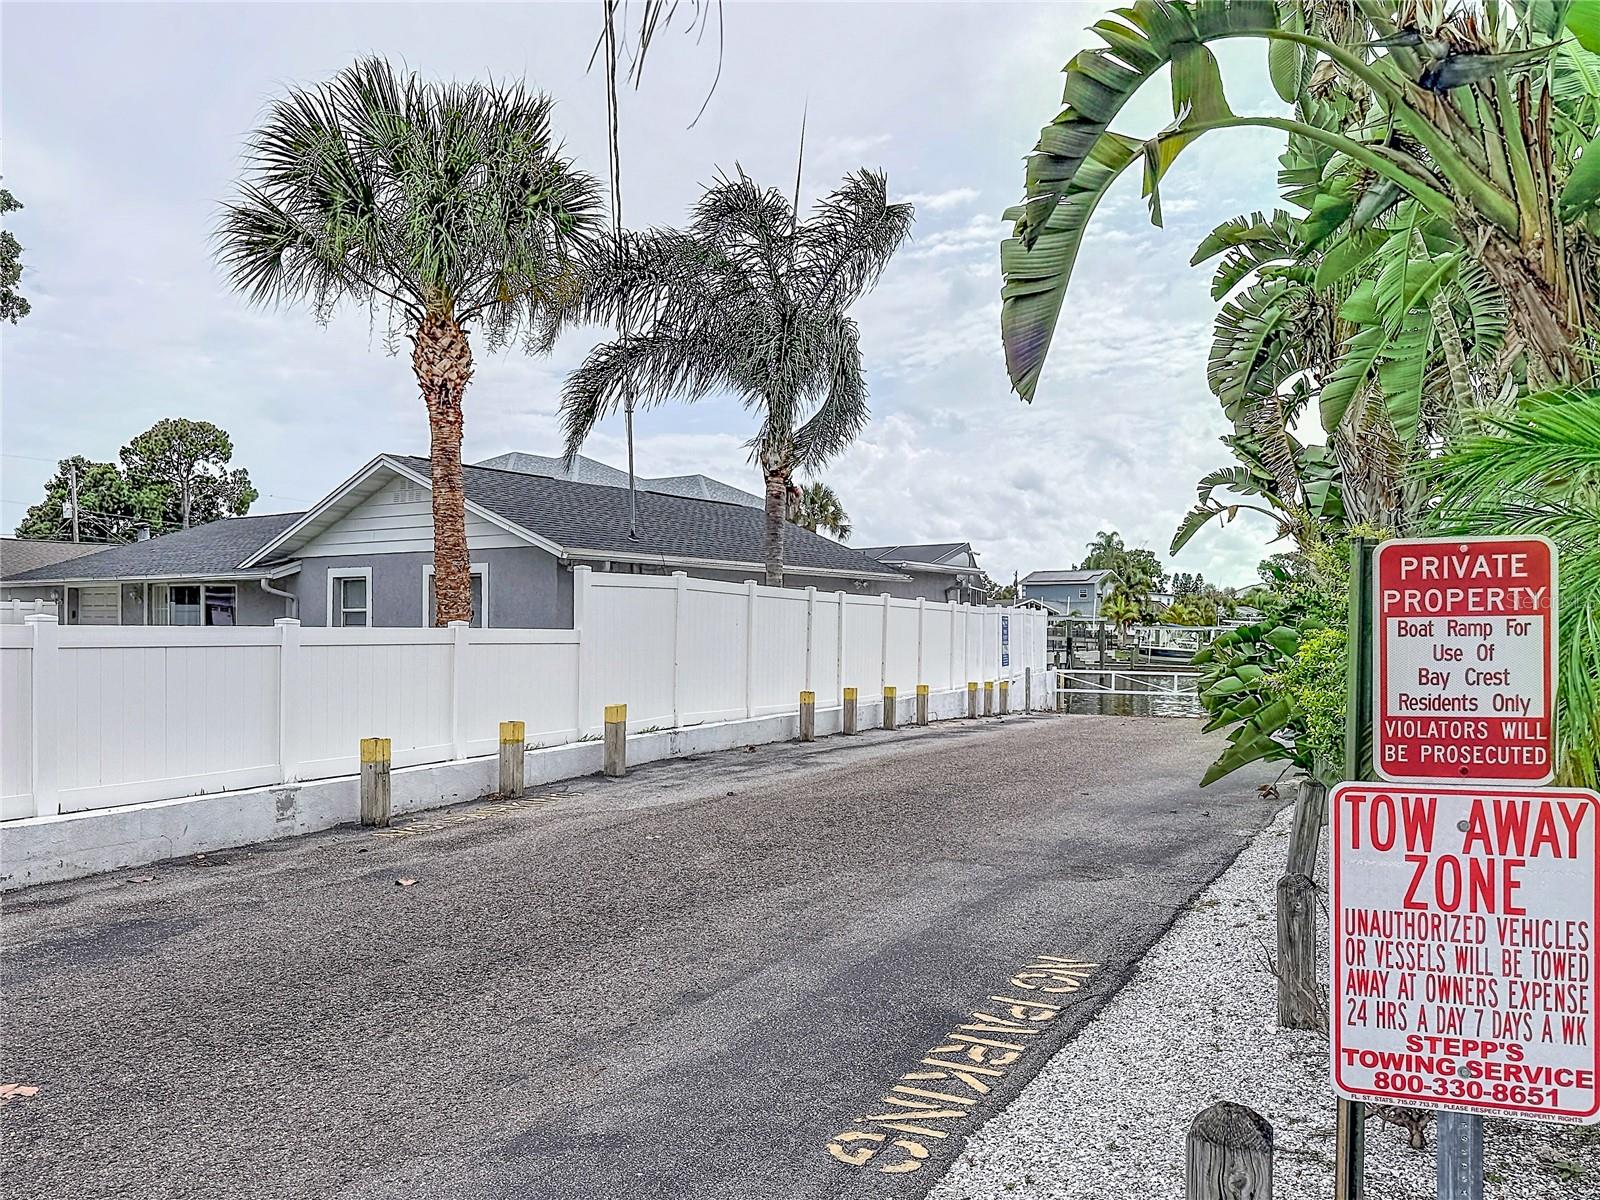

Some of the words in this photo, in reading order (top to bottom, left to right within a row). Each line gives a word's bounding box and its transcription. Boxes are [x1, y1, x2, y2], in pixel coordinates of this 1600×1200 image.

[1401, 553, 1528, 580] PRIVATE
[1383, 586, 1546, 613] PROPERTY
[1398, 620, 1434, 638] Boat
[1447, 619, 1493, 640] Ramp
[1506, 618, 1532, 637] For
[1433, 644, 1463, 662] Use
[1477, 644, 1495, 662] Of
[1418, 668, 1450, 690] Bay
[1465, 668, 1510, 686] Crest
[1399, 693, 1478, 711] Residents
[1493, 693, 1531, 716] Only
[1385, 720, 1488, 739] VIOLATORS
[1502, 722, 1547, 740] WILL
[1385, 744, 1408, 762] BE
[1420, 745, 1546, 764] PROSECUTED
[1344, 794, 1437, 853] TOW
[1462, 799, 1589, 859] AWAY
[1403, 854, 1526, 916] ZONE
[1345, 908, 1487, 945] UNAUTHORIZED
[1497, 917, 1589, 951] VEHICLES
[1009, 955, 1101, 993] NO
[1345, 938, 1366, 967] OR
[1375, 940, 1446, 973] VESSELS
[1455, 945, 1493, 976] WILL
[1502, 948, 1522, 978] BE
[1532, 950, 1589, 982] TOWED
[1346, 968, 1390, 998] AWAY
[1398, 970, 1416, 1001] AT
[1426, 973, 1499, 1008] OWNERS
[1508, 980, 1589, 1015] EXPENSE
[1347, 998, 1367, 1027] 24
[1376, 1001, 1407, 1031] HRS
[1417, 1004, 1428, 1033] A
[1436, 1005, 1466, 1036] DAY
[1474, 1008, 1484, 1037] 7
[1492, 1010, 1533, 1042] DAYS
[1542, 1014, 1553, 1043] A
[1561, 1015, 1587, 1046] WK
[1406, 1035, 1524, 1062] STEPP'S
[826, 995, 1062, 1173] PARKING
[1342, 1048, 1456, 1075] TOWING
[1466, 1060, 1593, 1090] SERVICE
[1374, 1072, 1559, 1107] 800-330-8651
[1443, 1103, 1469, 1112] PLEASE
[1470, 1106, 1502, 1116] RESPECT
[1503, 1110, 1518, 1118] OUR
[1520, 1112, 1556, 1121] PROPERTY
[1558, 1116, 1584, 1125] RIGHTS
